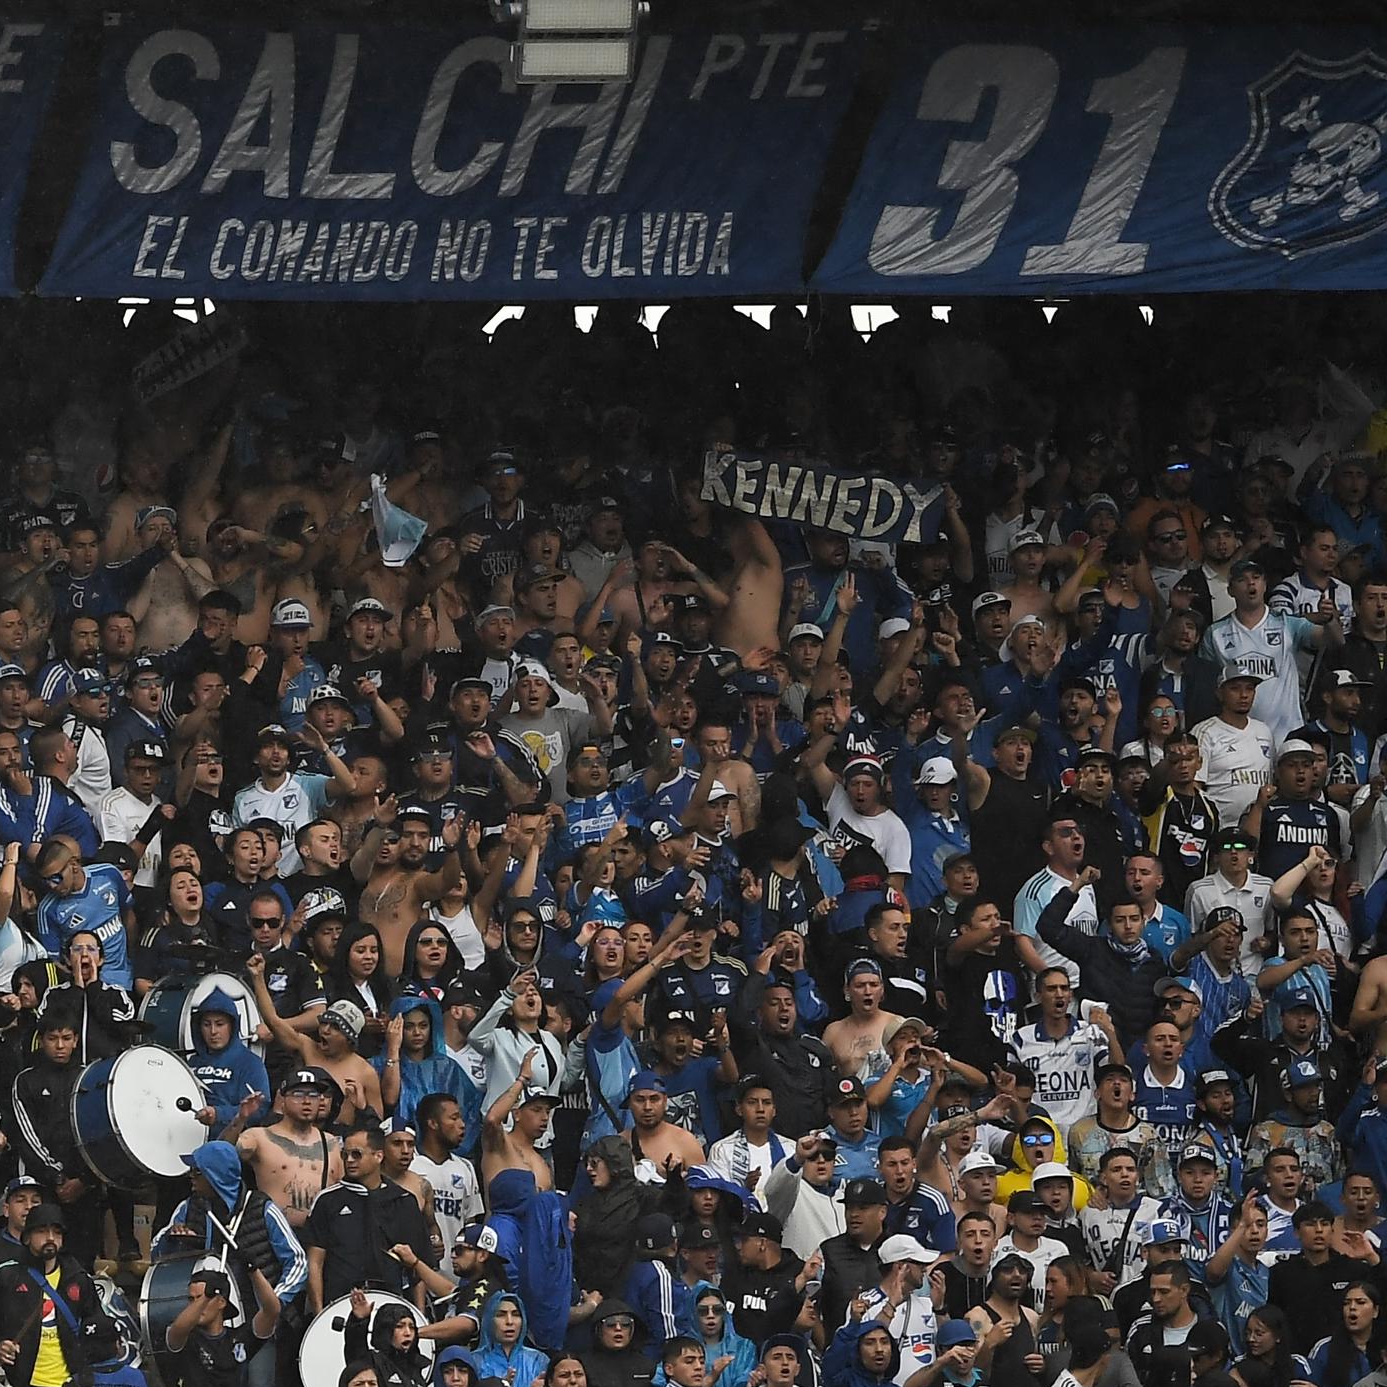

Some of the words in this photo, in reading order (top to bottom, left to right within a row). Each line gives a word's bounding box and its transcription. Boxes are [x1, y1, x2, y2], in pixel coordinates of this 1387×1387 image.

[109, 28, 674, 199] SALCHI
[690, 30, 846, 100] PTE
[867, 44, 1187, 276] 31
[133, 215, 188, 280] EL
[209, 216, 419, 283] COMANDO
[431, 219, 492, 283] NO
[513, 216, 559, 280] TE
[580, 211, 735, 280] OLVIDA
[700, 449, 943, 542] KENNEDY
[1276, 822, 1328, 845] ANDINA
[94, 915, 123, 942] DINA
[1035, 1070, 1091, 1092] EONA
